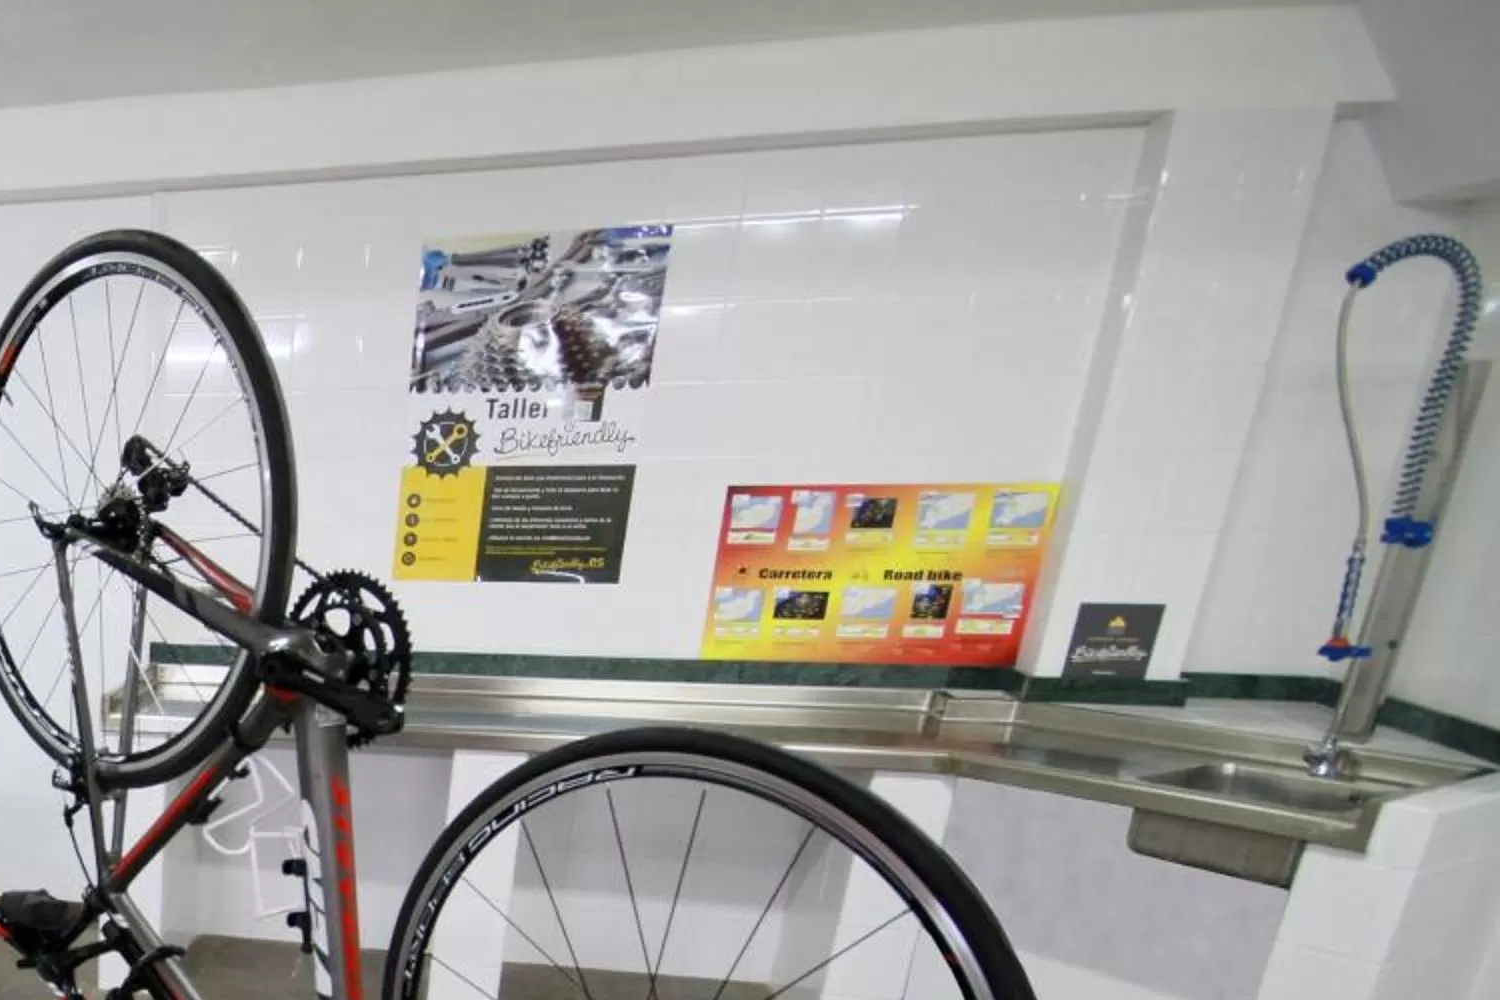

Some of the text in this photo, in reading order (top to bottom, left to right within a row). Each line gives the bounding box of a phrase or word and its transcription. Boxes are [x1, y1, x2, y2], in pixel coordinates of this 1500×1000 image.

[758, 568, 833, 581] Carretera
[883, 569, 963, 581] Road bike
